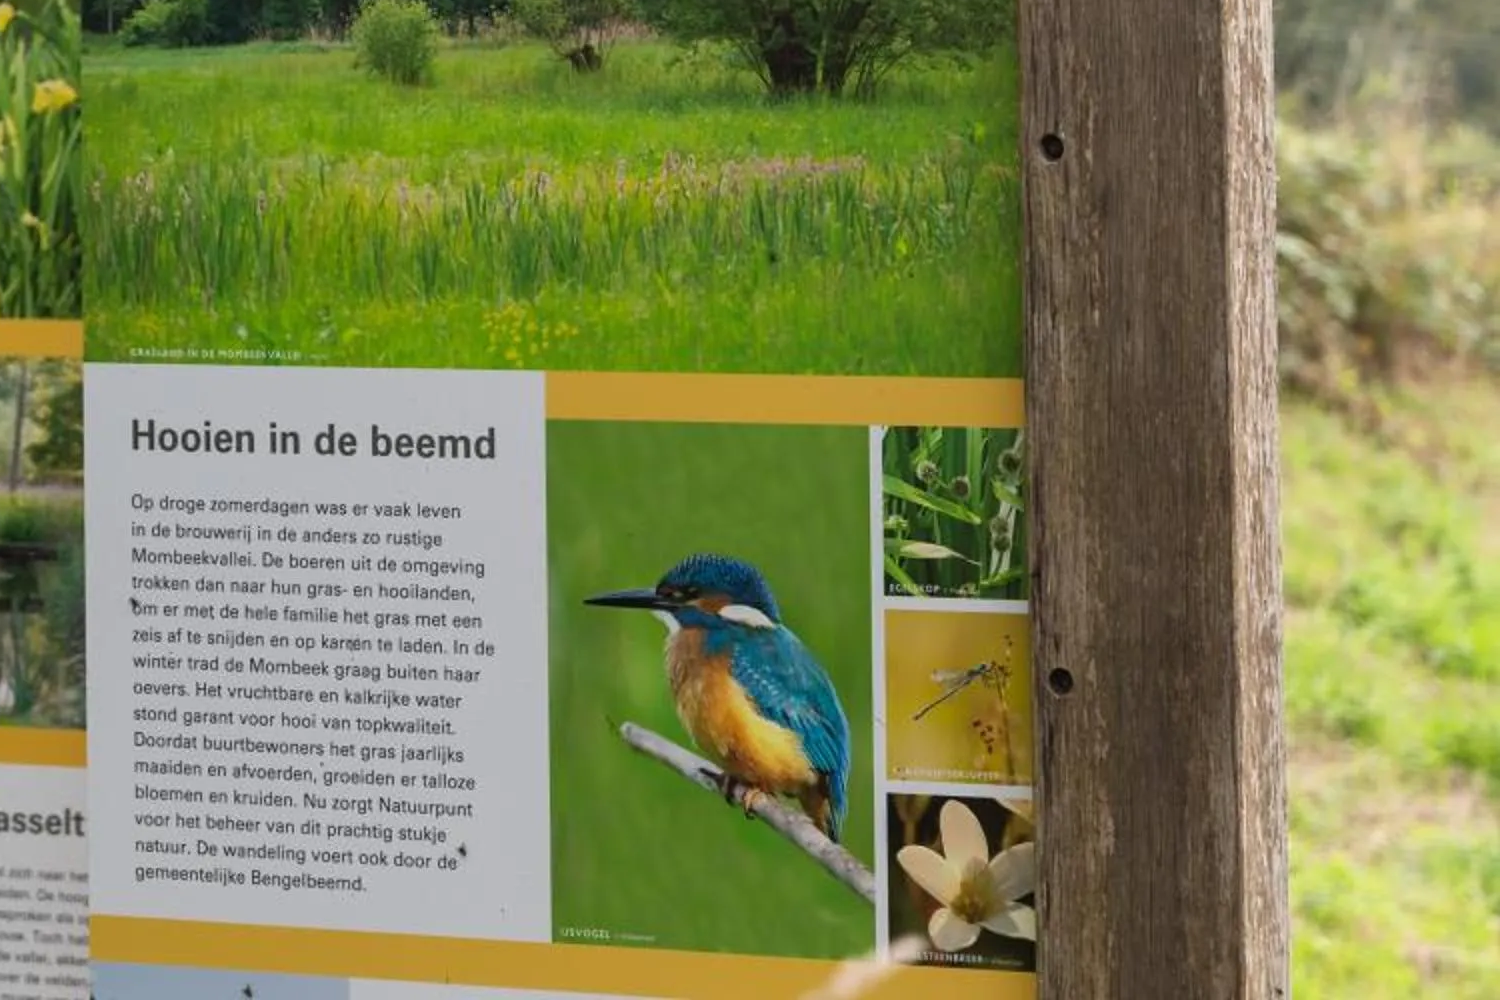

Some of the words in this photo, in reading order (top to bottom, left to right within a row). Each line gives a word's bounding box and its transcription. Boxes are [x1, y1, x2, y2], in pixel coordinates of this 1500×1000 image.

[131, 419, 255, 454] Hooien
[269, 422, 300, 455] in
[314, 424, 357, 457] de
[371, 425, 496, 459] beemd
[131, 493, 154, 514] Op
[158, 494, 206, 515] droge
[208, 498, 309, 517] zomerdagen
[314, 503, 347, 519] was
[351, 503, 368, 520] er
[372, 502, 413, 519] vaak
[416, 502, 461, 519] leven
[131, 520, 146, 537] in
[150, 521, 170, 538] de
[175, 523, 252, 543] brouwerij
[256, 524, 272, 541] in
[276, 525, 296, 542] de
[302, 527, 357, 547] anders
[361, 532, 380, 544] zo
[386, 530, 442, 550] rustige
[132, 547, 256, 567] Mombeekvallei.
[261, 551, 284, 568] De
[288, 552, 345, 570] boeren
[350, 554, 372, 571] uit
[377, 555, 396, 572] de
[400, 557, 484, 578] omgeving
[131, 573, 190, 593] trokken
[195, 576, 224, 595] dan
[230, 581, 265, 596] naar
[271, 578, 301, 595] hun
[306, 583, 347, 599] gras-
[352, 580, 372, 598] en
[378, 583, 474, 602] hooilanden,
[162, 601, 179, 616] er
[183, 604, 215, 620] met
[219, 603, 238, 619] de
[282, 605, 338, 622] familie
[343, 607, 369, 625] het
[371, 612, 411, 629] gras
[414, 613, 448, 631] met
[451, 615, 482, 631] een
[132, 626, 162, 646] zeis
[166, 627, 184, 647] af
[186, 629, 202, 648] te
[206, 629, 264, 648] snijden
[270, 634, 289, 647] en
[293, 635, 316, 652] op
[377, 637, 392, 653] te
[453, 638, 468, 655] In
[473, 639, 494, 657] de
[132, 652, 182, 669] winter
[186, 654, 218, 675] trad
[224, 656, 244, 672] de
[249, 657, 329, 677] Mombeek
[334, 664, 383, 682] graag
[386, 663, 438, 680] buiten
[443, 665, 480, 682] haar
[195, 681, 222, 698] Het
[318, 688, 338, 704] en
[414, 694, 462, 711] water
[133, 706, 177, 725] stond
[181, 711, 234, 726] garant
[238, 710, 276, 727] voor
[279, 712, 316, 728] hooi
[321, 715, 351, 731] van
[132, 730, 197, 752] Doordat
[329, 740, 356, 759] het
[359, 744, 397, 762] gras
[134, 759, 202, 775] maaiden
[207, 762, 226, 776] en
[232, 763, 317, 783] afvoerden,
[400, 774, 417, 787] er
[134, 784, 203, 802] bloemen
[208, 791, 228, 804] en
[231, 789, 297, 807] kruiden.
[303, 792, 326, 809] Nu
[331, 796, 373, 816] zorgt
[376, 796, 472, 819] Natuurpunt
[134, 812, 172, 826] voor
[175, 812, 200, 831] het
[205, 814, 260, 832] beheer
[265, 820, 294, 834] van
[300, 819, 322, 836] dit
[326, 822, 392, 842] prachtig
[398, 826, 447, 846] stukje
[194, 839, 218, 857] De
[222, 844, 306, 865] wandeling
[311, 847, 353, 865] voert
[356, 850, 388, 867] ook
[393, 851, 432, 869] door
[437, 856, 458, 871] de
